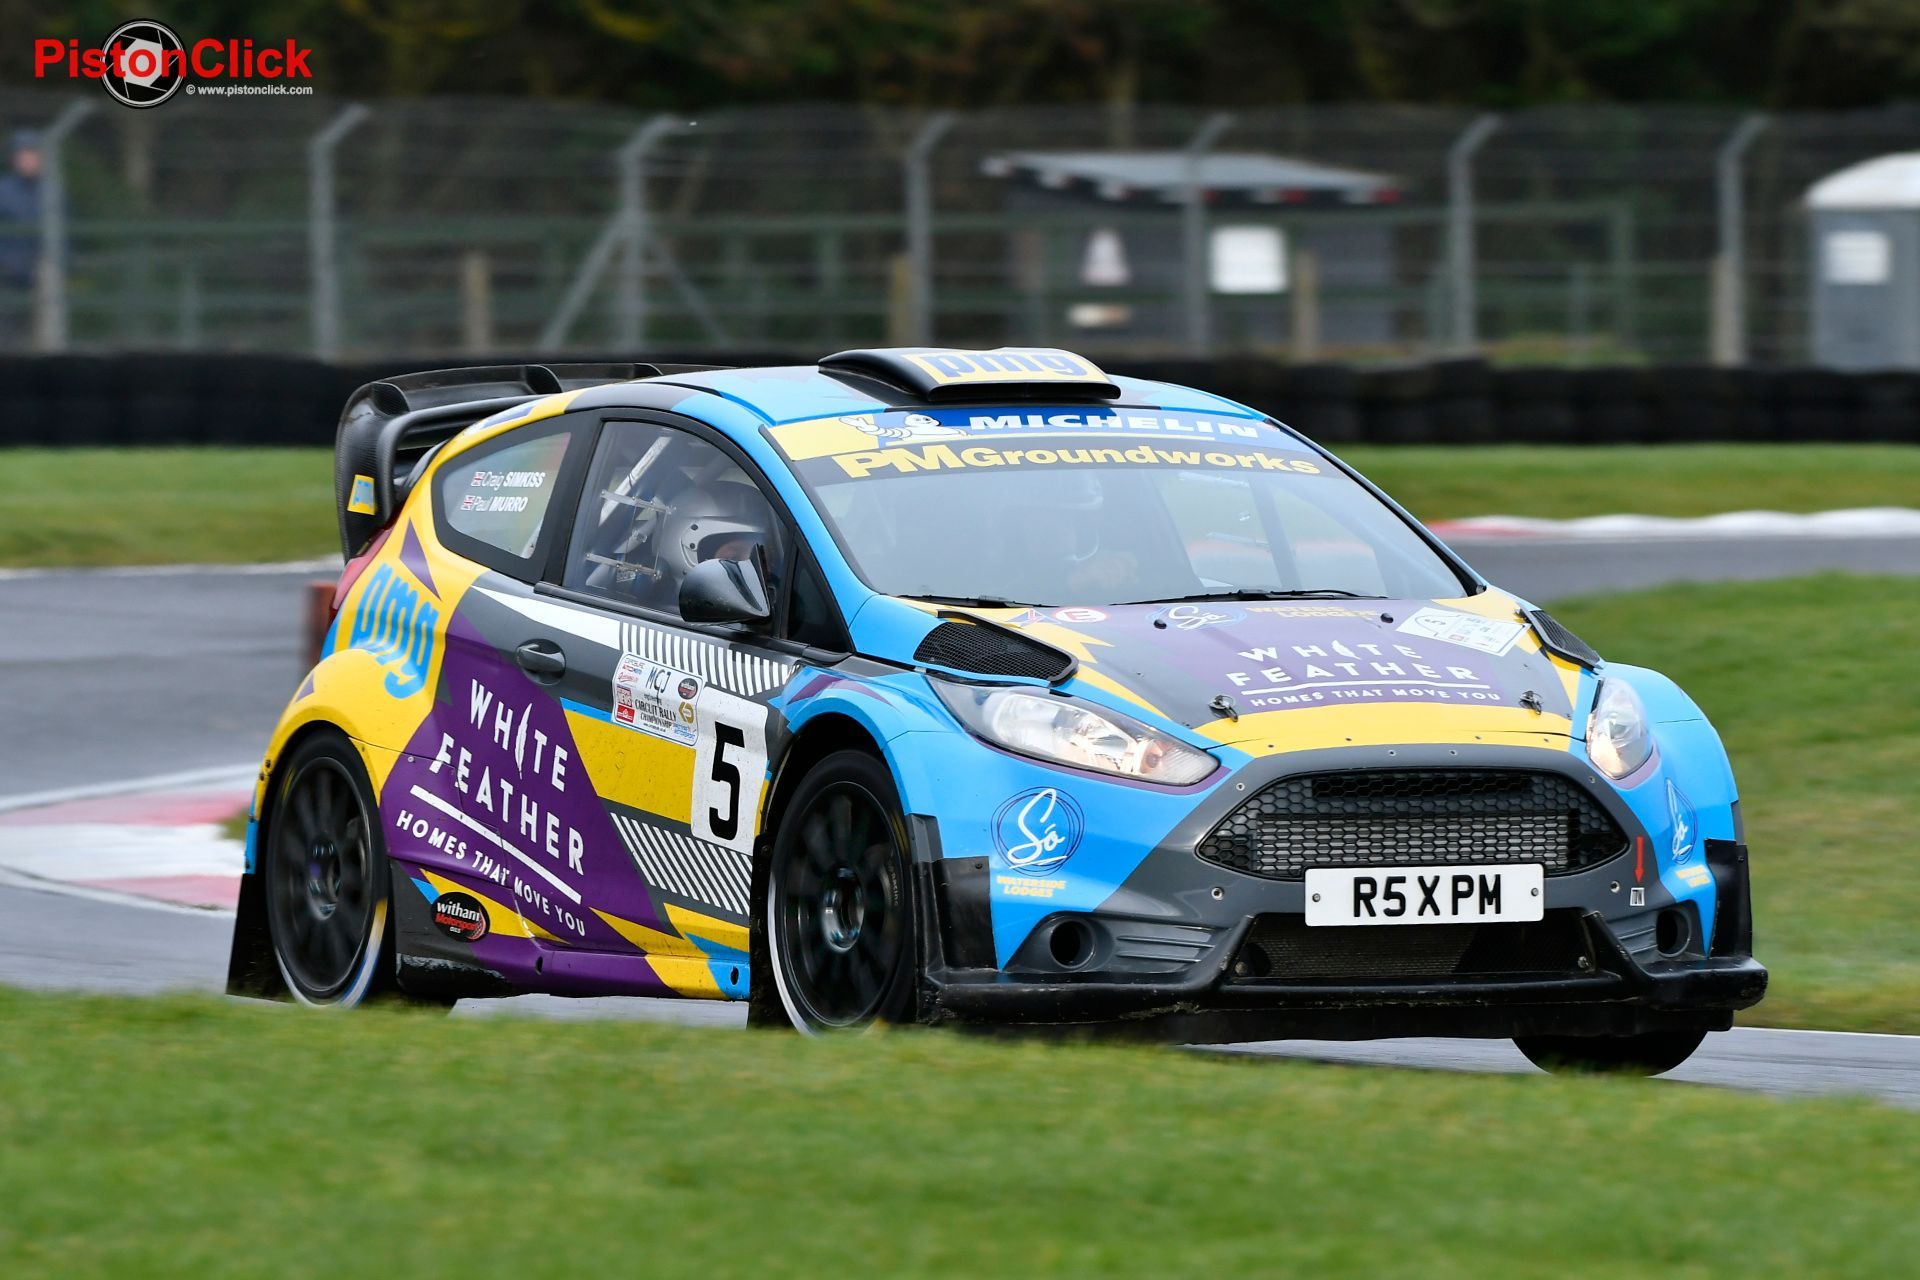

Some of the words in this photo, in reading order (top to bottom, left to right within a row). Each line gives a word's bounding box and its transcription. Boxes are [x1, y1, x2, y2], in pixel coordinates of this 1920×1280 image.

[969, 414, 1259, 438] MICHELIN
[503, 471, 546, 488] SIMKISS
[489, 496, 529, 512] MURRO
[1237, 640, 1422, 662] WHITE
[1226, 662, 1480, 687] FEATHER
[1250, 691, 1324, 707] HOMES
[1332, 689, 1384, 698] THAT
[1392, 688, 1451, 699] MOVE
[1457, 691, 1501, 701] YOU
[470, 678, 568, 792] WHITE
[709, 721, 745, 841] 5
[429, 732, 584, 875] FEATHER
[396, 810, 467, 860] HOMES
[472, 850, 510, 886] THAT
[514, 876, 550, 915] MOVE
[554, 905, 586, 937] YOU
[437, 901, 480, 922] witham
